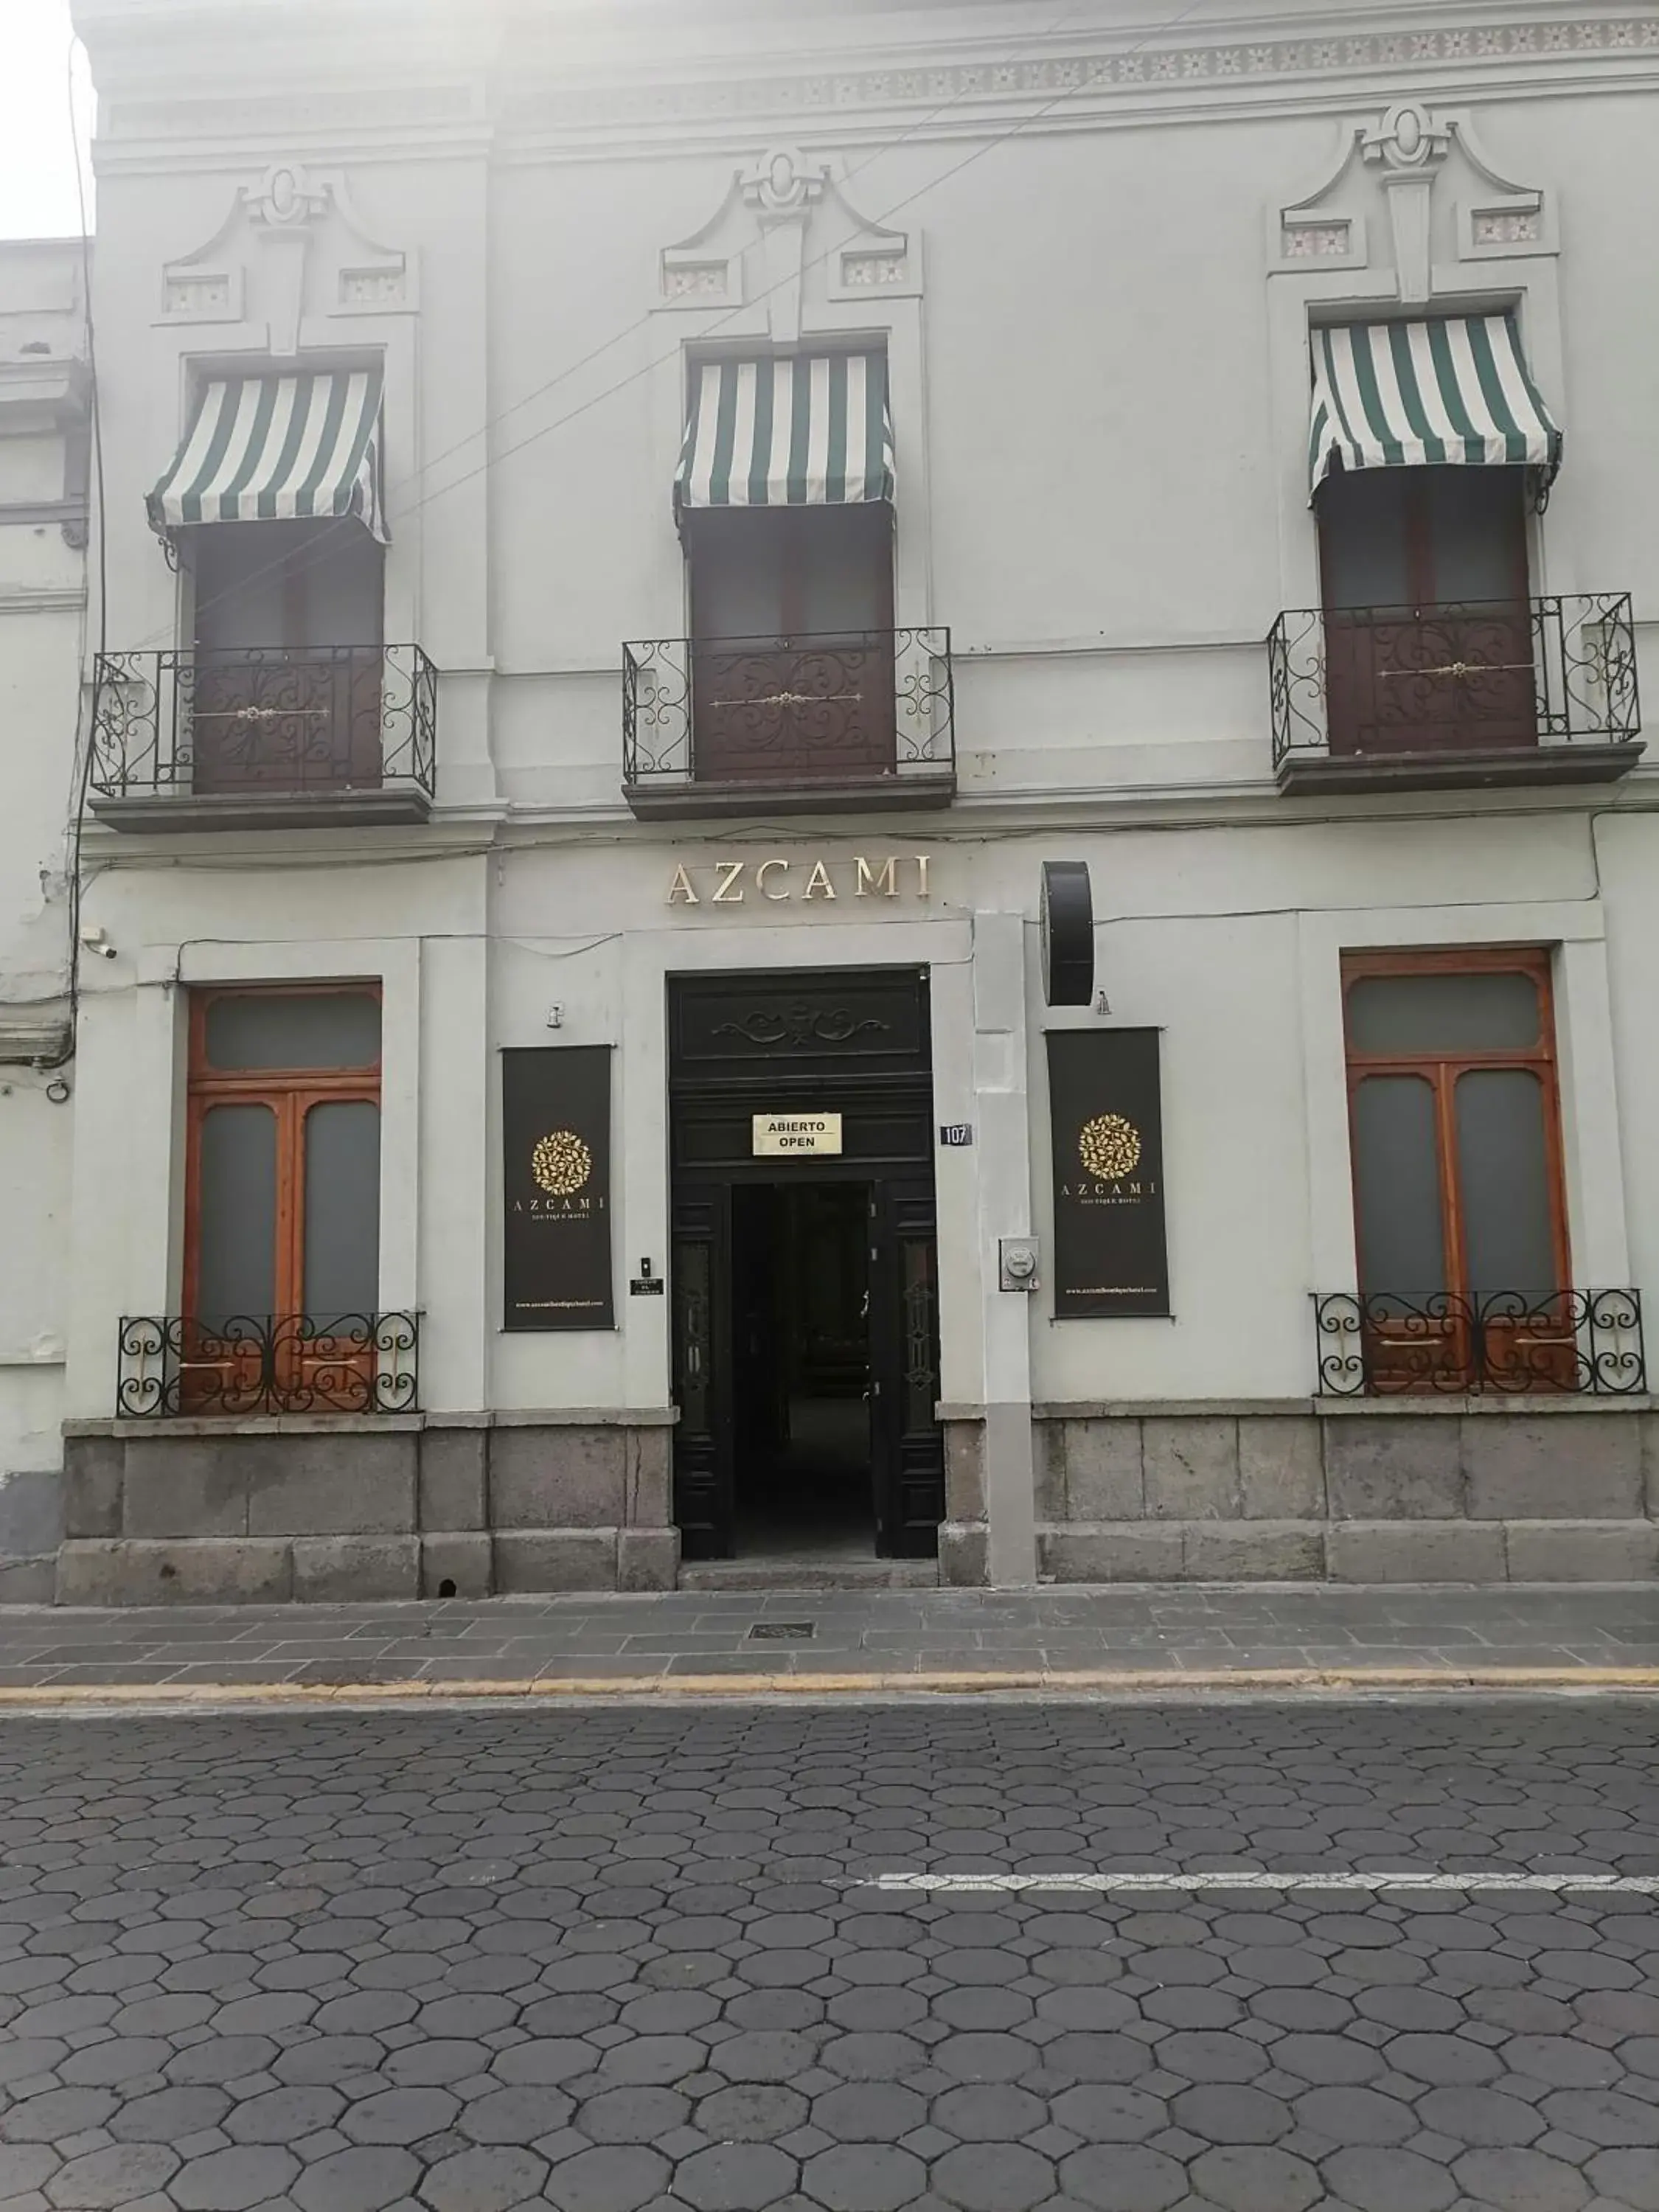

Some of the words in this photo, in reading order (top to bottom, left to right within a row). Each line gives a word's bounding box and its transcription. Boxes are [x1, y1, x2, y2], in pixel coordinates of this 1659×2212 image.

[665, 855, 931, 904] AZCAMI
[768, 1121, 825, 1132] ABIERTO
[946, 1127, 966, 1143] 107
[779, 1137, 814, 1147] OPEN
[1062, 1182, 1155, 1195] AZCAMI
[514, 1197, 603, 1211] AZCAMI
